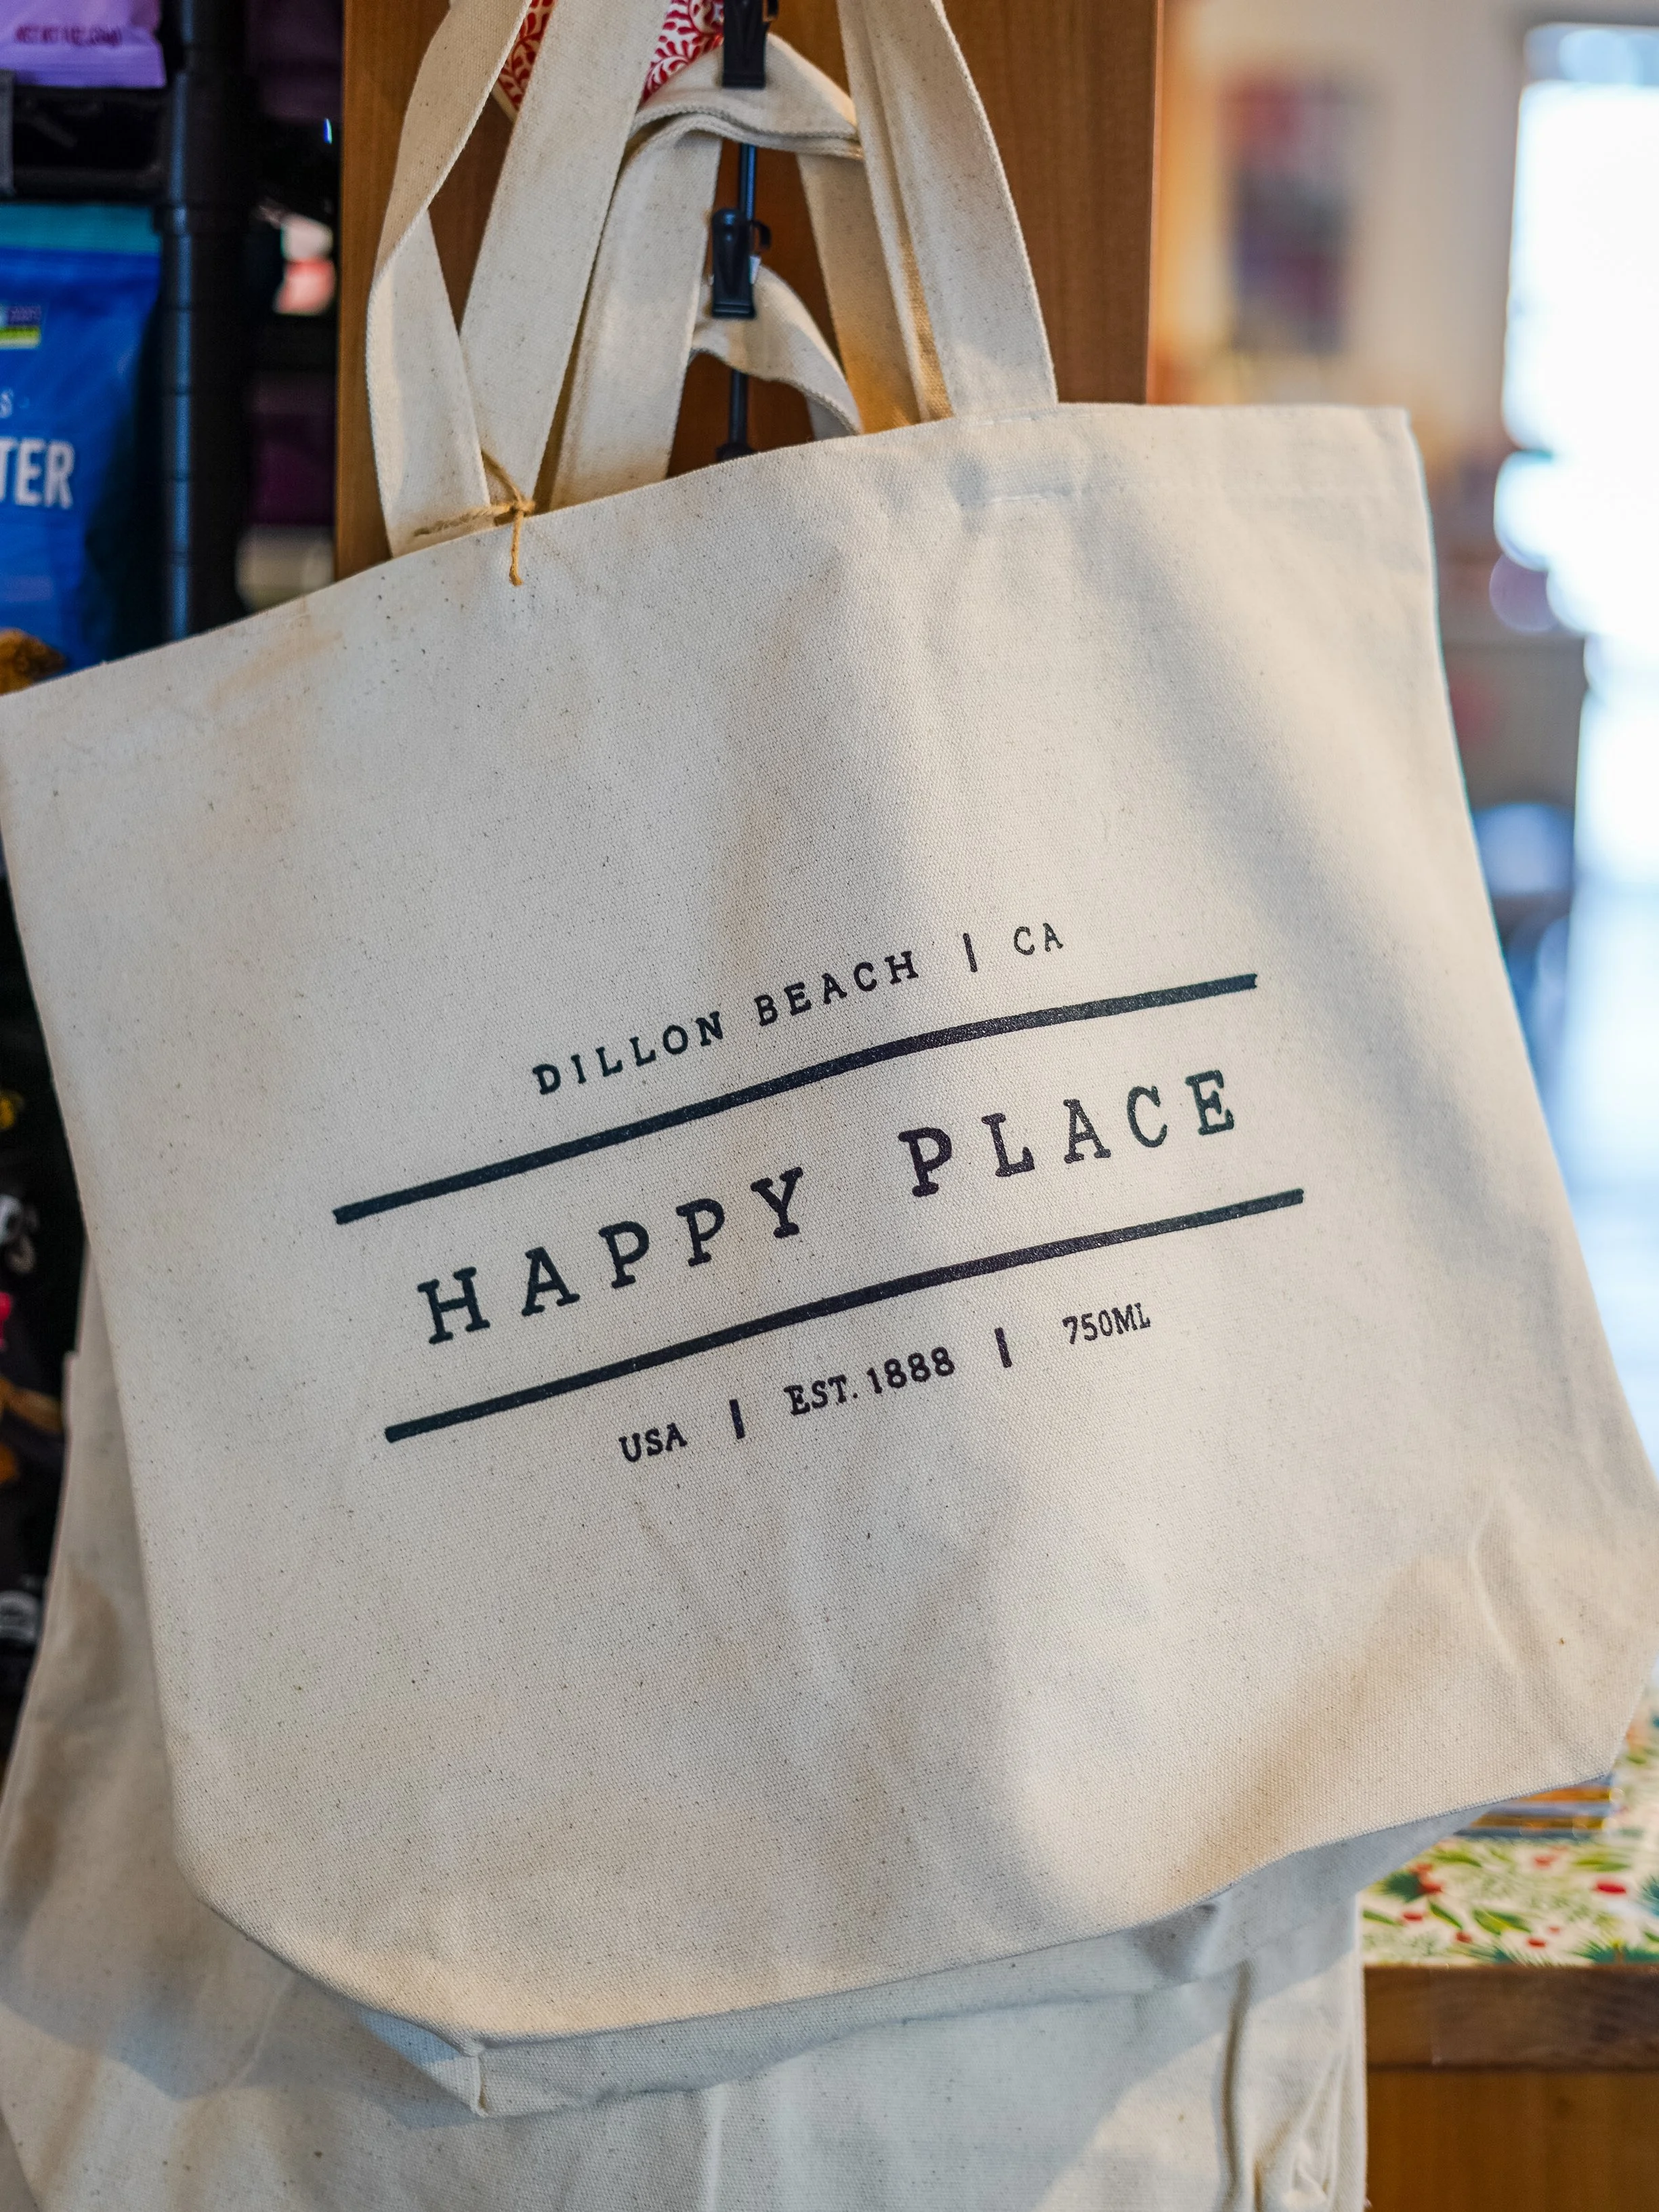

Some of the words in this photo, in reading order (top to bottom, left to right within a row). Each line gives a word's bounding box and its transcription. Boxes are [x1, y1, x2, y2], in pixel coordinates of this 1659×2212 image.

[532, 1010, 723, 1095] DILLON
[753, 951, 919, 1027] BEACH
[1013, 923, 1064, 955] CA
[417, 1166, 804, 1345] HAPPY
[897, 1070, 1235, 1198] PLACE
[618, 1422, 689, 1463] USA
[782, 1374, 860, 1417] EST.
[865, 1346, 956, 1394] 1888
[1062, 1302, 1152, 1345] 750ML
